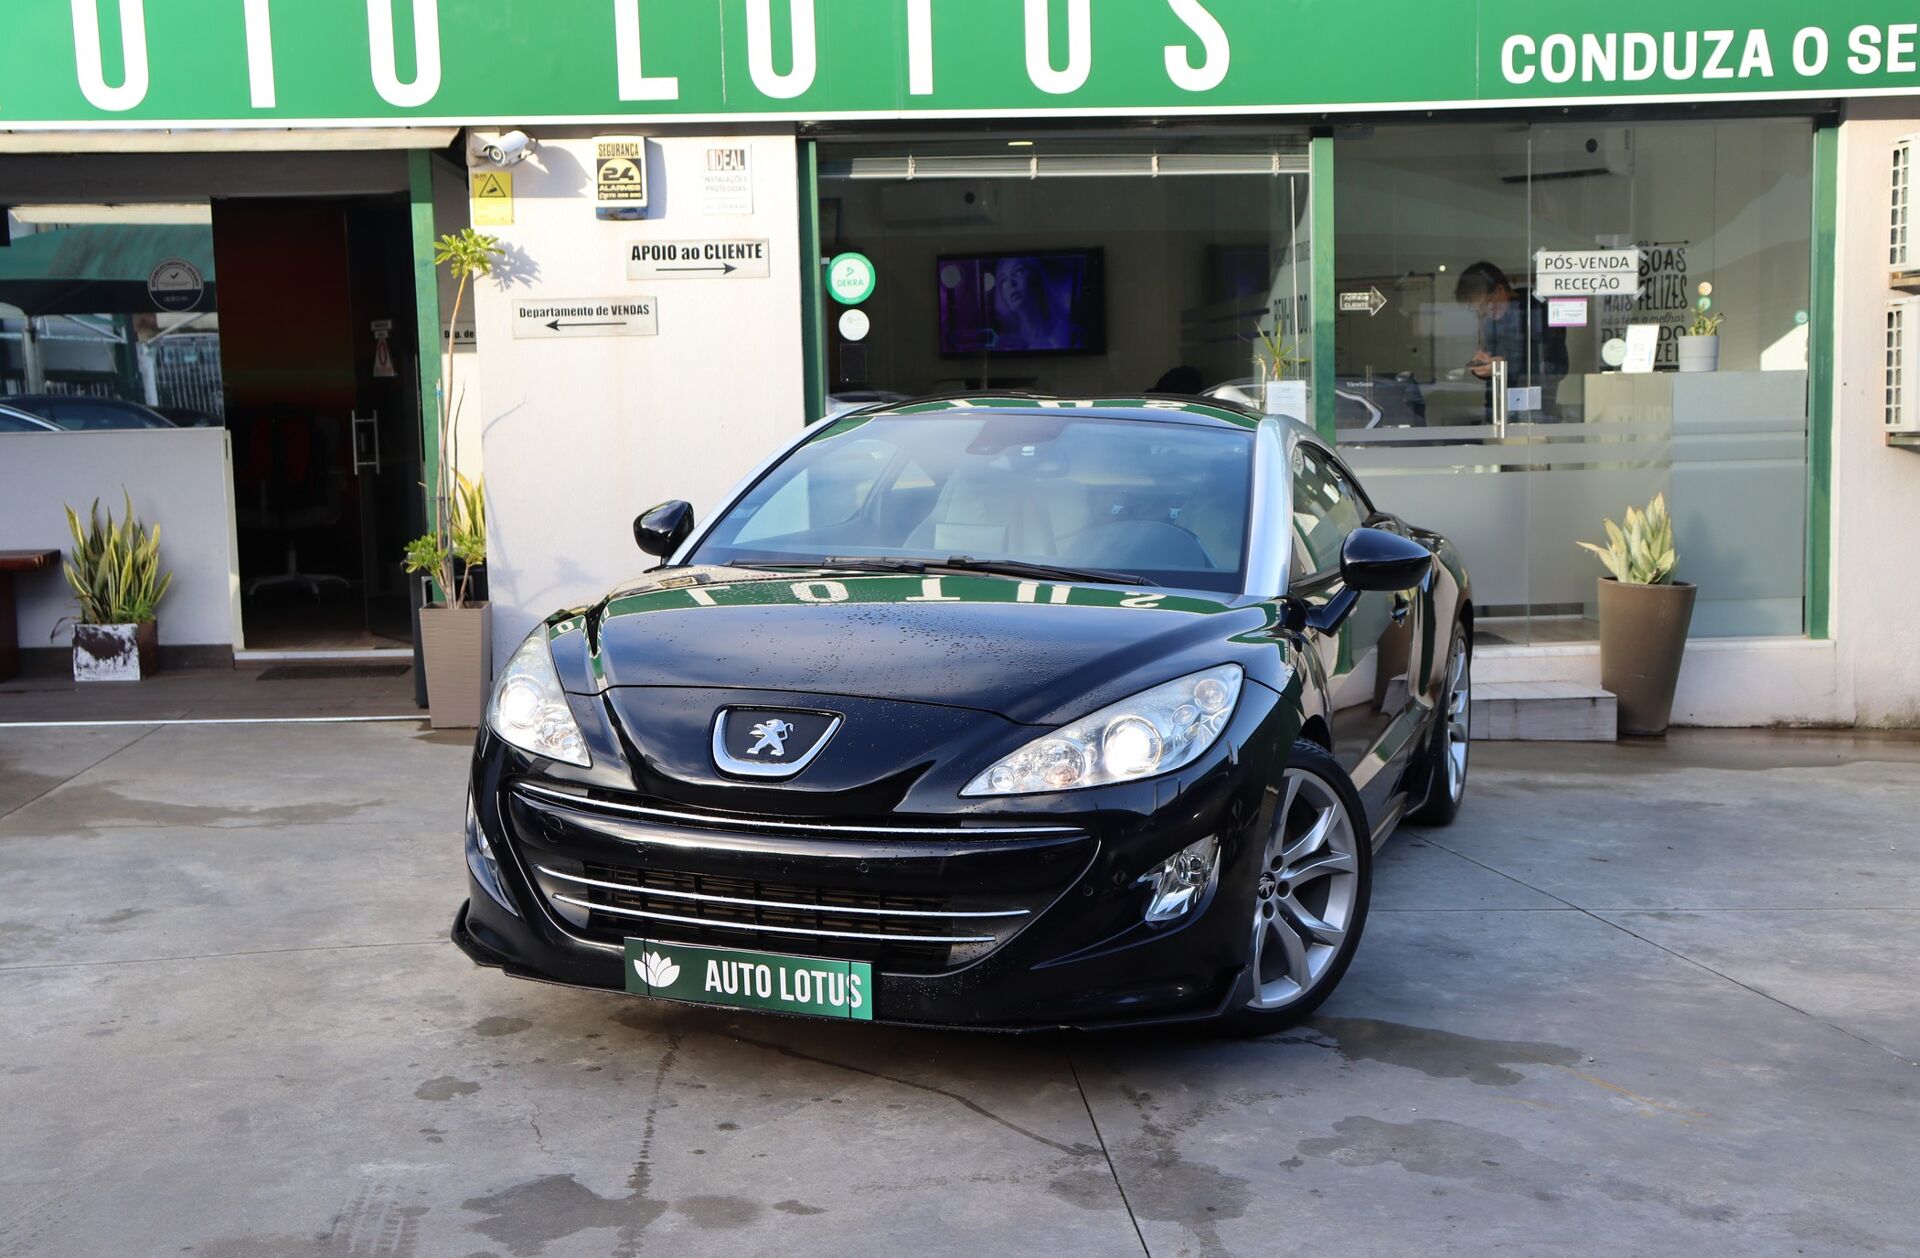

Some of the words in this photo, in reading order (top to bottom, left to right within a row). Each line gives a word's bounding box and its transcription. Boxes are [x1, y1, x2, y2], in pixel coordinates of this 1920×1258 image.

[1501, 28, 1775, 86] CONDUZA
[1793, 26, 1830, 77] O
[706, 149, 746, 171] IDEAL
[603, 167, 634, 181] 24
[631, 244, 677, 261] APOIO
[681, 246, 700, 260] ao
[704, 243, 763, 260] CLIENTE
[1544, 254, 1630, 270] PÓS-VENDA
[837, 279, 864, 288] DEKRA
[1554, 274, 1620, 293] RECEÇÃO
[519, 306, 594, 319] Departamento
[596, 305, 609, 316] de
[611, 304, 650, 316] VENDAS
[704, 959, 772, 999] AUTO
[779, 966, 863, 1009] LOTUS
